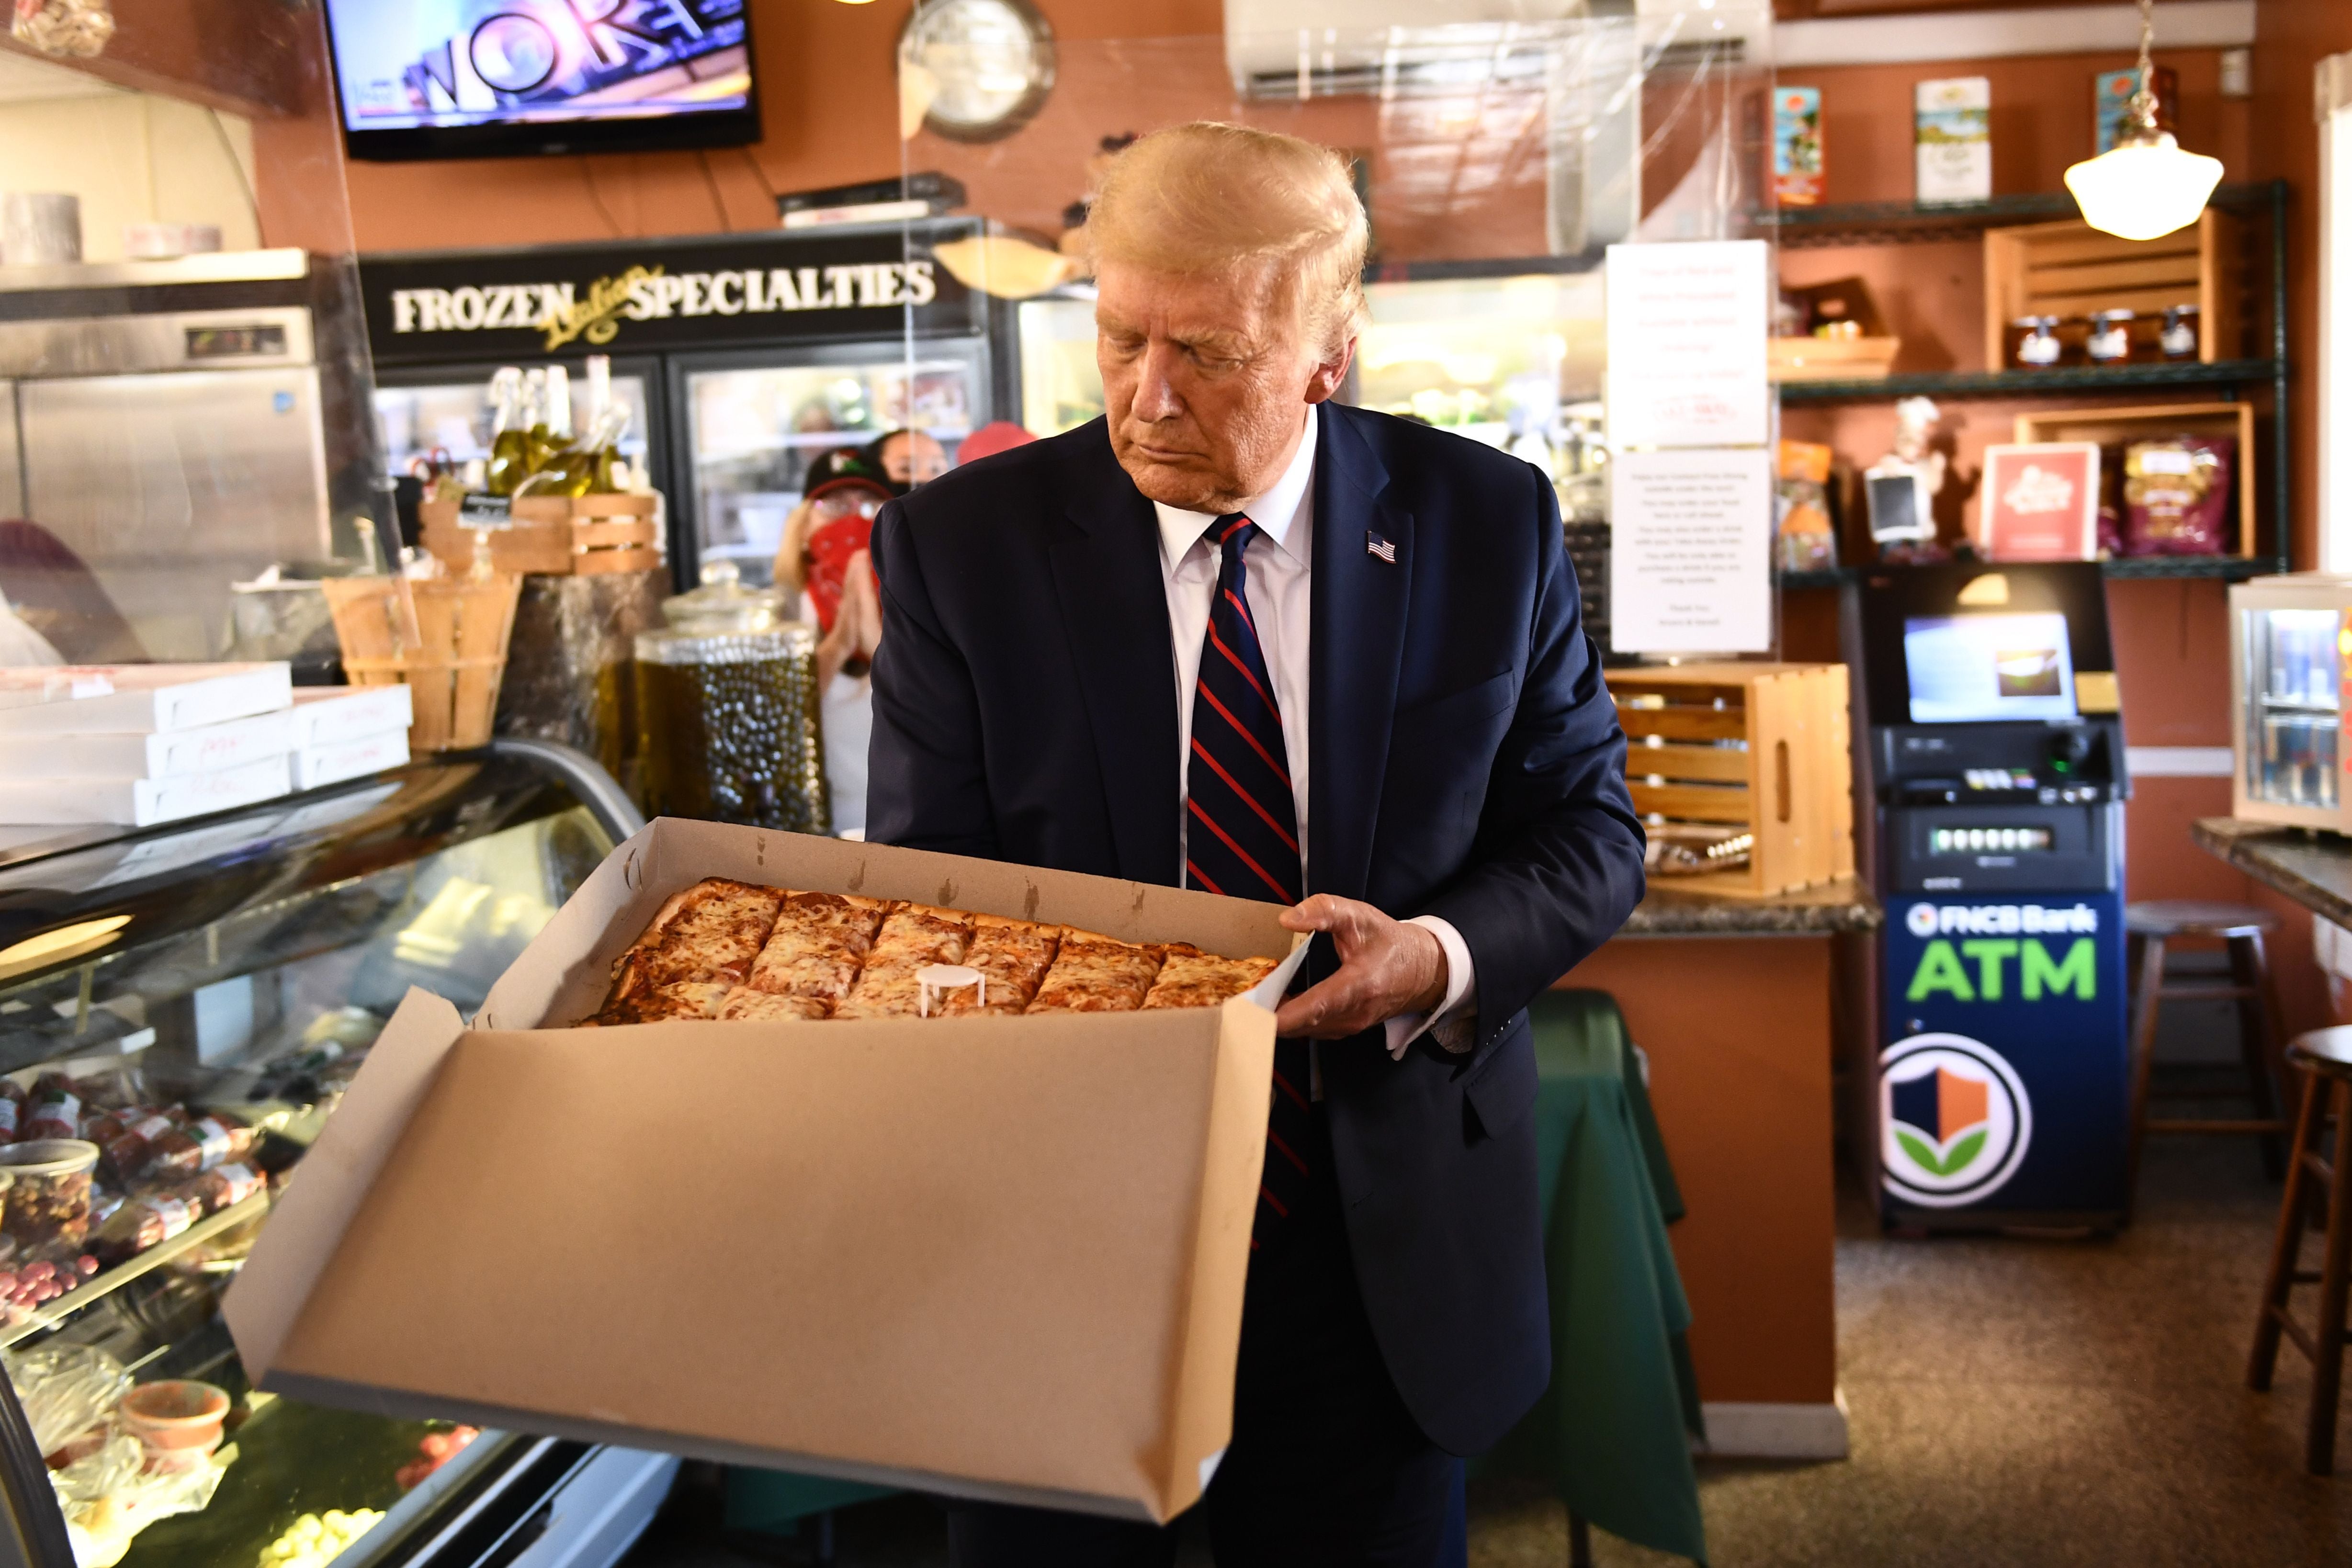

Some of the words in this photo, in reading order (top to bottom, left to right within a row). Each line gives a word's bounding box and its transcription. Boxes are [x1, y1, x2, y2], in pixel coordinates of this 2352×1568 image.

[392, 282, 575, 333] FROZEN
[624, 260, 936, 321] SPECIALTIES
[1907, 938, 2097, 1001] ATM
